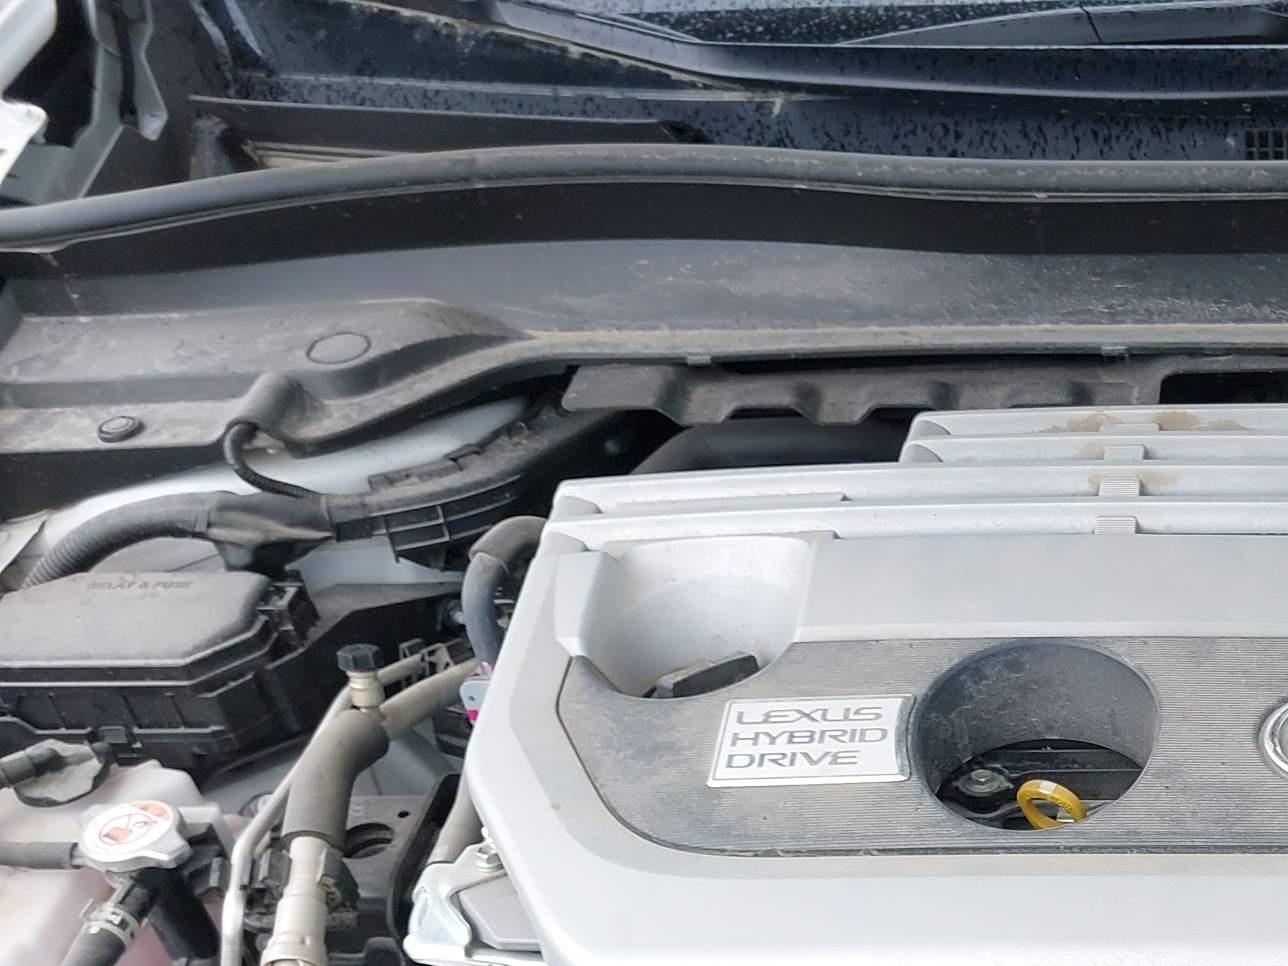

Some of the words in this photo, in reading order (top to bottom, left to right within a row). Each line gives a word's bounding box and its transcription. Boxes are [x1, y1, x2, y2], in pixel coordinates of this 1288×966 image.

[735, 706, 883, 725] LEXUS
[729, 727, 889, 747] HYBRID
[724, 749, 861, 769] DRIVE
